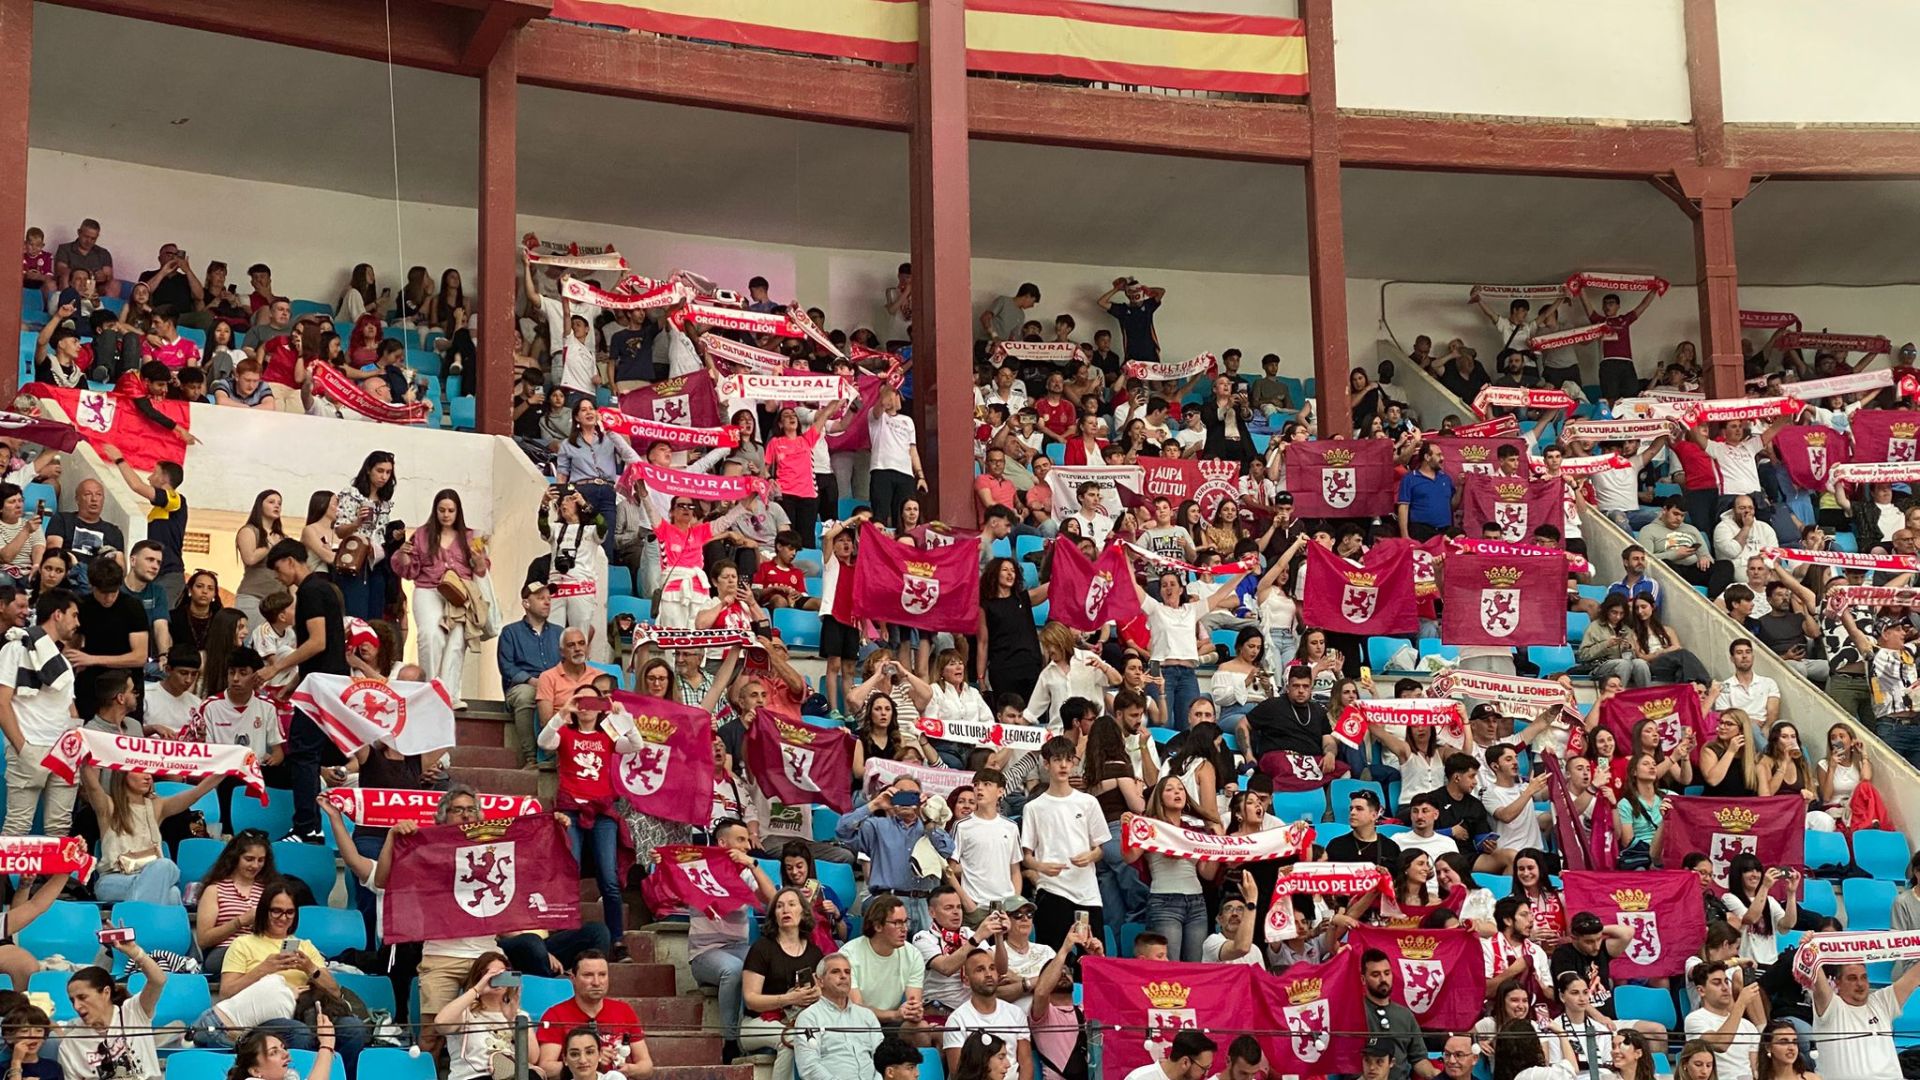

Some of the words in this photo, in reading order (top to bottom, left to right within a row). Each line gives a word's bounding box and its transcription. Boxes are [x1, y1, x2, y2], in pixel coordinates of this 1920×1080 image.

[1586, 279, 1618, 289] ORGULLO
[695, 315, 738, 329] ORGULLO
[739, 321, 750, 331] DE
[752, 321, 777, 334] LEÓN
[1004, 342, 1073, 351] CULTURAL
[722, 342, 753, 359] CULTURAL
[753, 353, 781, 366] LEONESA
[748, 377, 834, 388] CULTURAL
[1707, 410, 1747, 420] ORGULLO
[1748, 409, 1757, 417] DE
[631, 425, 677, 442] ORGULLO
[678, 431, 691, 443] DE
[693, 431, 719, 445] LEÓN
[1623, 424, 1662, 433] LEONESA
[1149, 467, 1183, 481] ¡AUPA
[1576, 466, 1587, 474] DE
[644, 466, 744, 491] CULTURAL
[1148, 481, 1187, 497] CULTU!
[1461, 677, 1515, 694] CULTURAL
[1517, 685, 1566, 697] LEONESA
[1411, 713, 1424, 725] DE
[1426, 710, 1453, 725] LEÓN
[948, 723, 991, 739] CULTURAL
[1004, 729, 1042, 744] LEONESA
[115, 736, 213, 758] CULTURAL
[125, 757, 165, 769] DEPORTIVA
[166, 762, 199, 770] LEONESA
[1183, 830, 1258, 846] CULTURAL
[1193, 847, 1225, 856] DEPORTIVA
[1331, 880, 1347, 892] DE
[1819, 939, 1886, 953] CULTURAL
